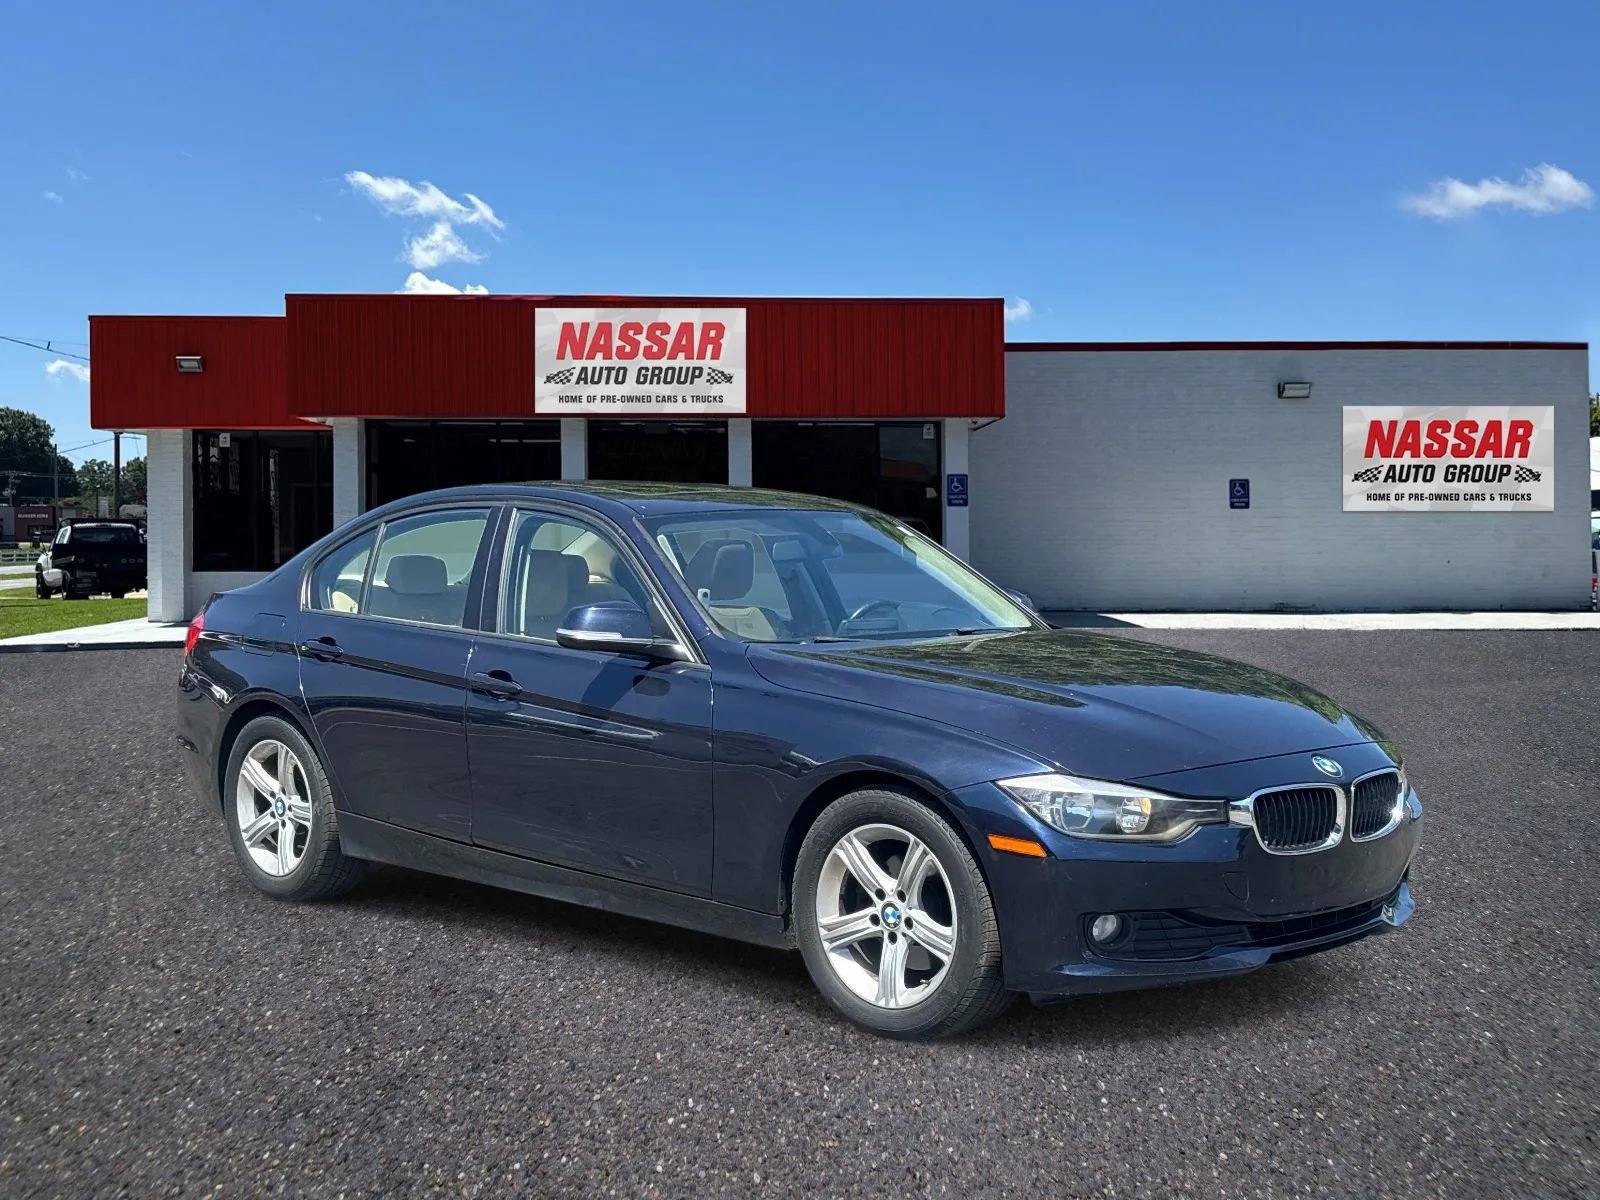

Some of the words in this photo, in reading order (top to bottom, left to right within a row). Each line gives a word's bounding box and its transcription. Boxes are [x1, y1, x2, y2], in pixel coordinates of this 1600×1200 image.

[556, 322, 725, 360] NASSAR
[575, 367, 627, 384] AUTO
[636, 367, 703, 384] GROUP
[559, 395, 582, 403] HOME
[587, 395, 596, 403] OF
[601, 395, 651, 403] PRE-OWNED
[656, 395, 677, 403] CARS
[691, 395, 723, 403] TRUCKS
[1364, 420, 1533, 458] NASSAR
[1383, 465, 1436, 483] AUTO
[1444, 465, 1511, 483] GROUP
[1367, 493, 1390, 501] HOME
[1395, 493, 1405, 501] OF
[1409, 493, 1459, 501] PRE-OWNED
[1464, 493, 1485, 501] CARS
[1490, 493, 1495, 501] &
[1499, 493, 1531, 501] TRUCKS
